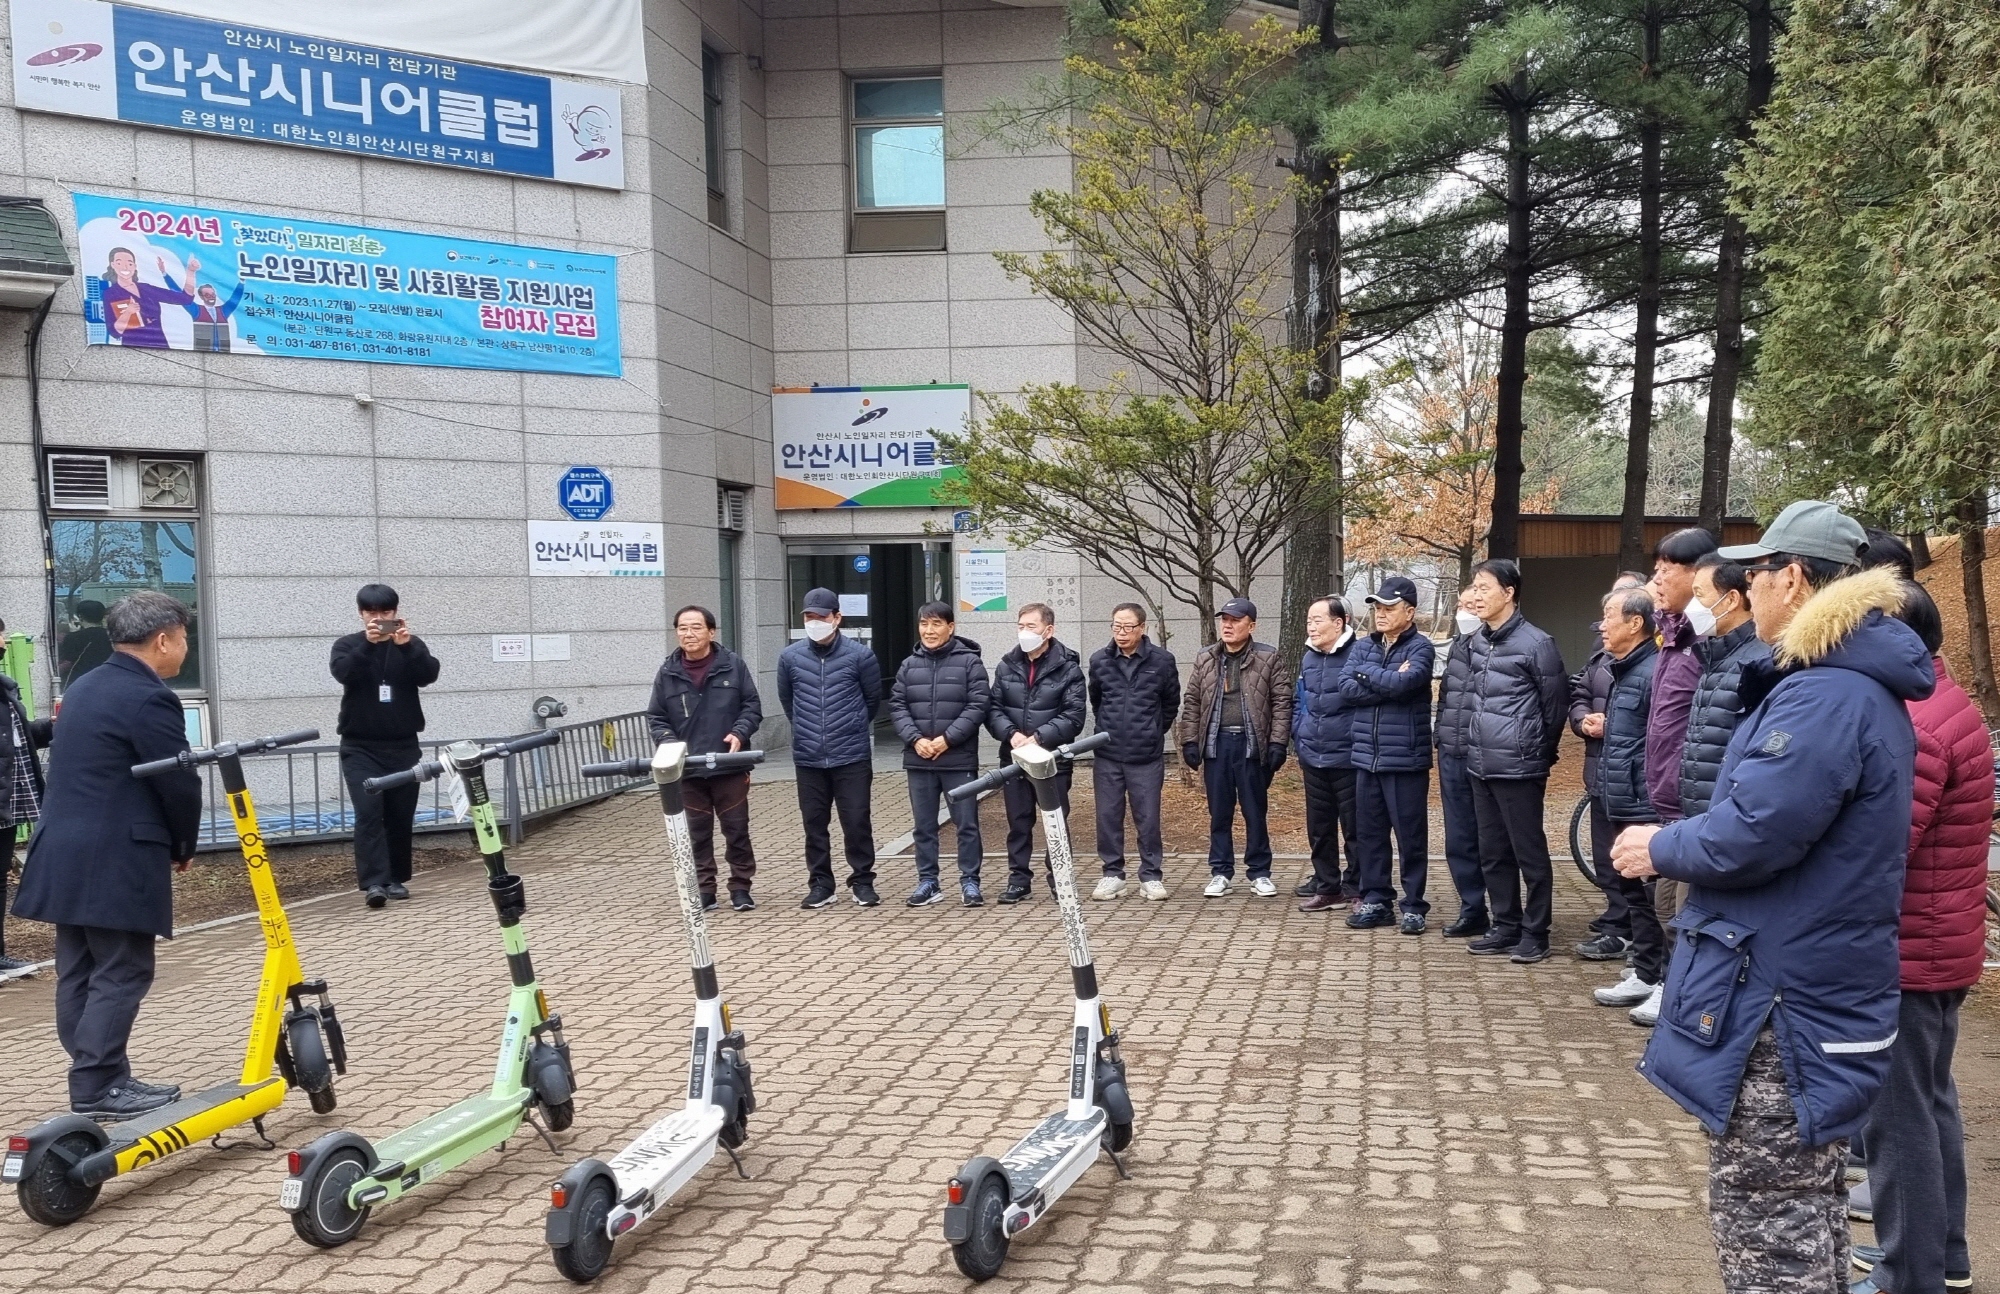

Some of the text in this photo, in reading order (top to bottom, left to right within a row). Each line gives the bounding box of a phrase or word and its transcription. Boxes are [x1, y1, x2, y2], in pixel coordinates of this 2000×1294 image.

[223, 26, 457, 81] 안산시 노인일자리 전담기관
[51, 77, 71, 88] 행복한
[72, 80, 86, 89] 복지
[87, 82, 101, 91] 안산
[128, 40, 539, 149] 안산시니어클럽
[180, 108, 255, 134] 운영법인
[273, 121, 495, 166] 대한노인회안산시단원구지회
[118, 209, 221, 244] 2024년
[297, 233, 346, 253] 일자리
[347, 235, 385, 257] 청춘
[238, 253, 594, 310] 노인일자리 및 사회활동 지원사업
[244, 306, 276, 319] 접수처
[283, 309, 354, 325] 안산시니어클럽
[282, 295, 357, 312] 2023.11.27(월)
[368, 302, 413, 317] 모집(선발)
[415, 307, 443, 319] 완료시
[481, 305, 596, 338] 참여자 모집
[362, 343, 432, 358] 031-401-8181
[816, 430, 923, 441] 안산시 노인일자리 전담기관
[803, 472, 834, 481] 운영법인
[569, 484, 604, 503] ADT
[535, 541, 658, 563] 안산시니어클럽
